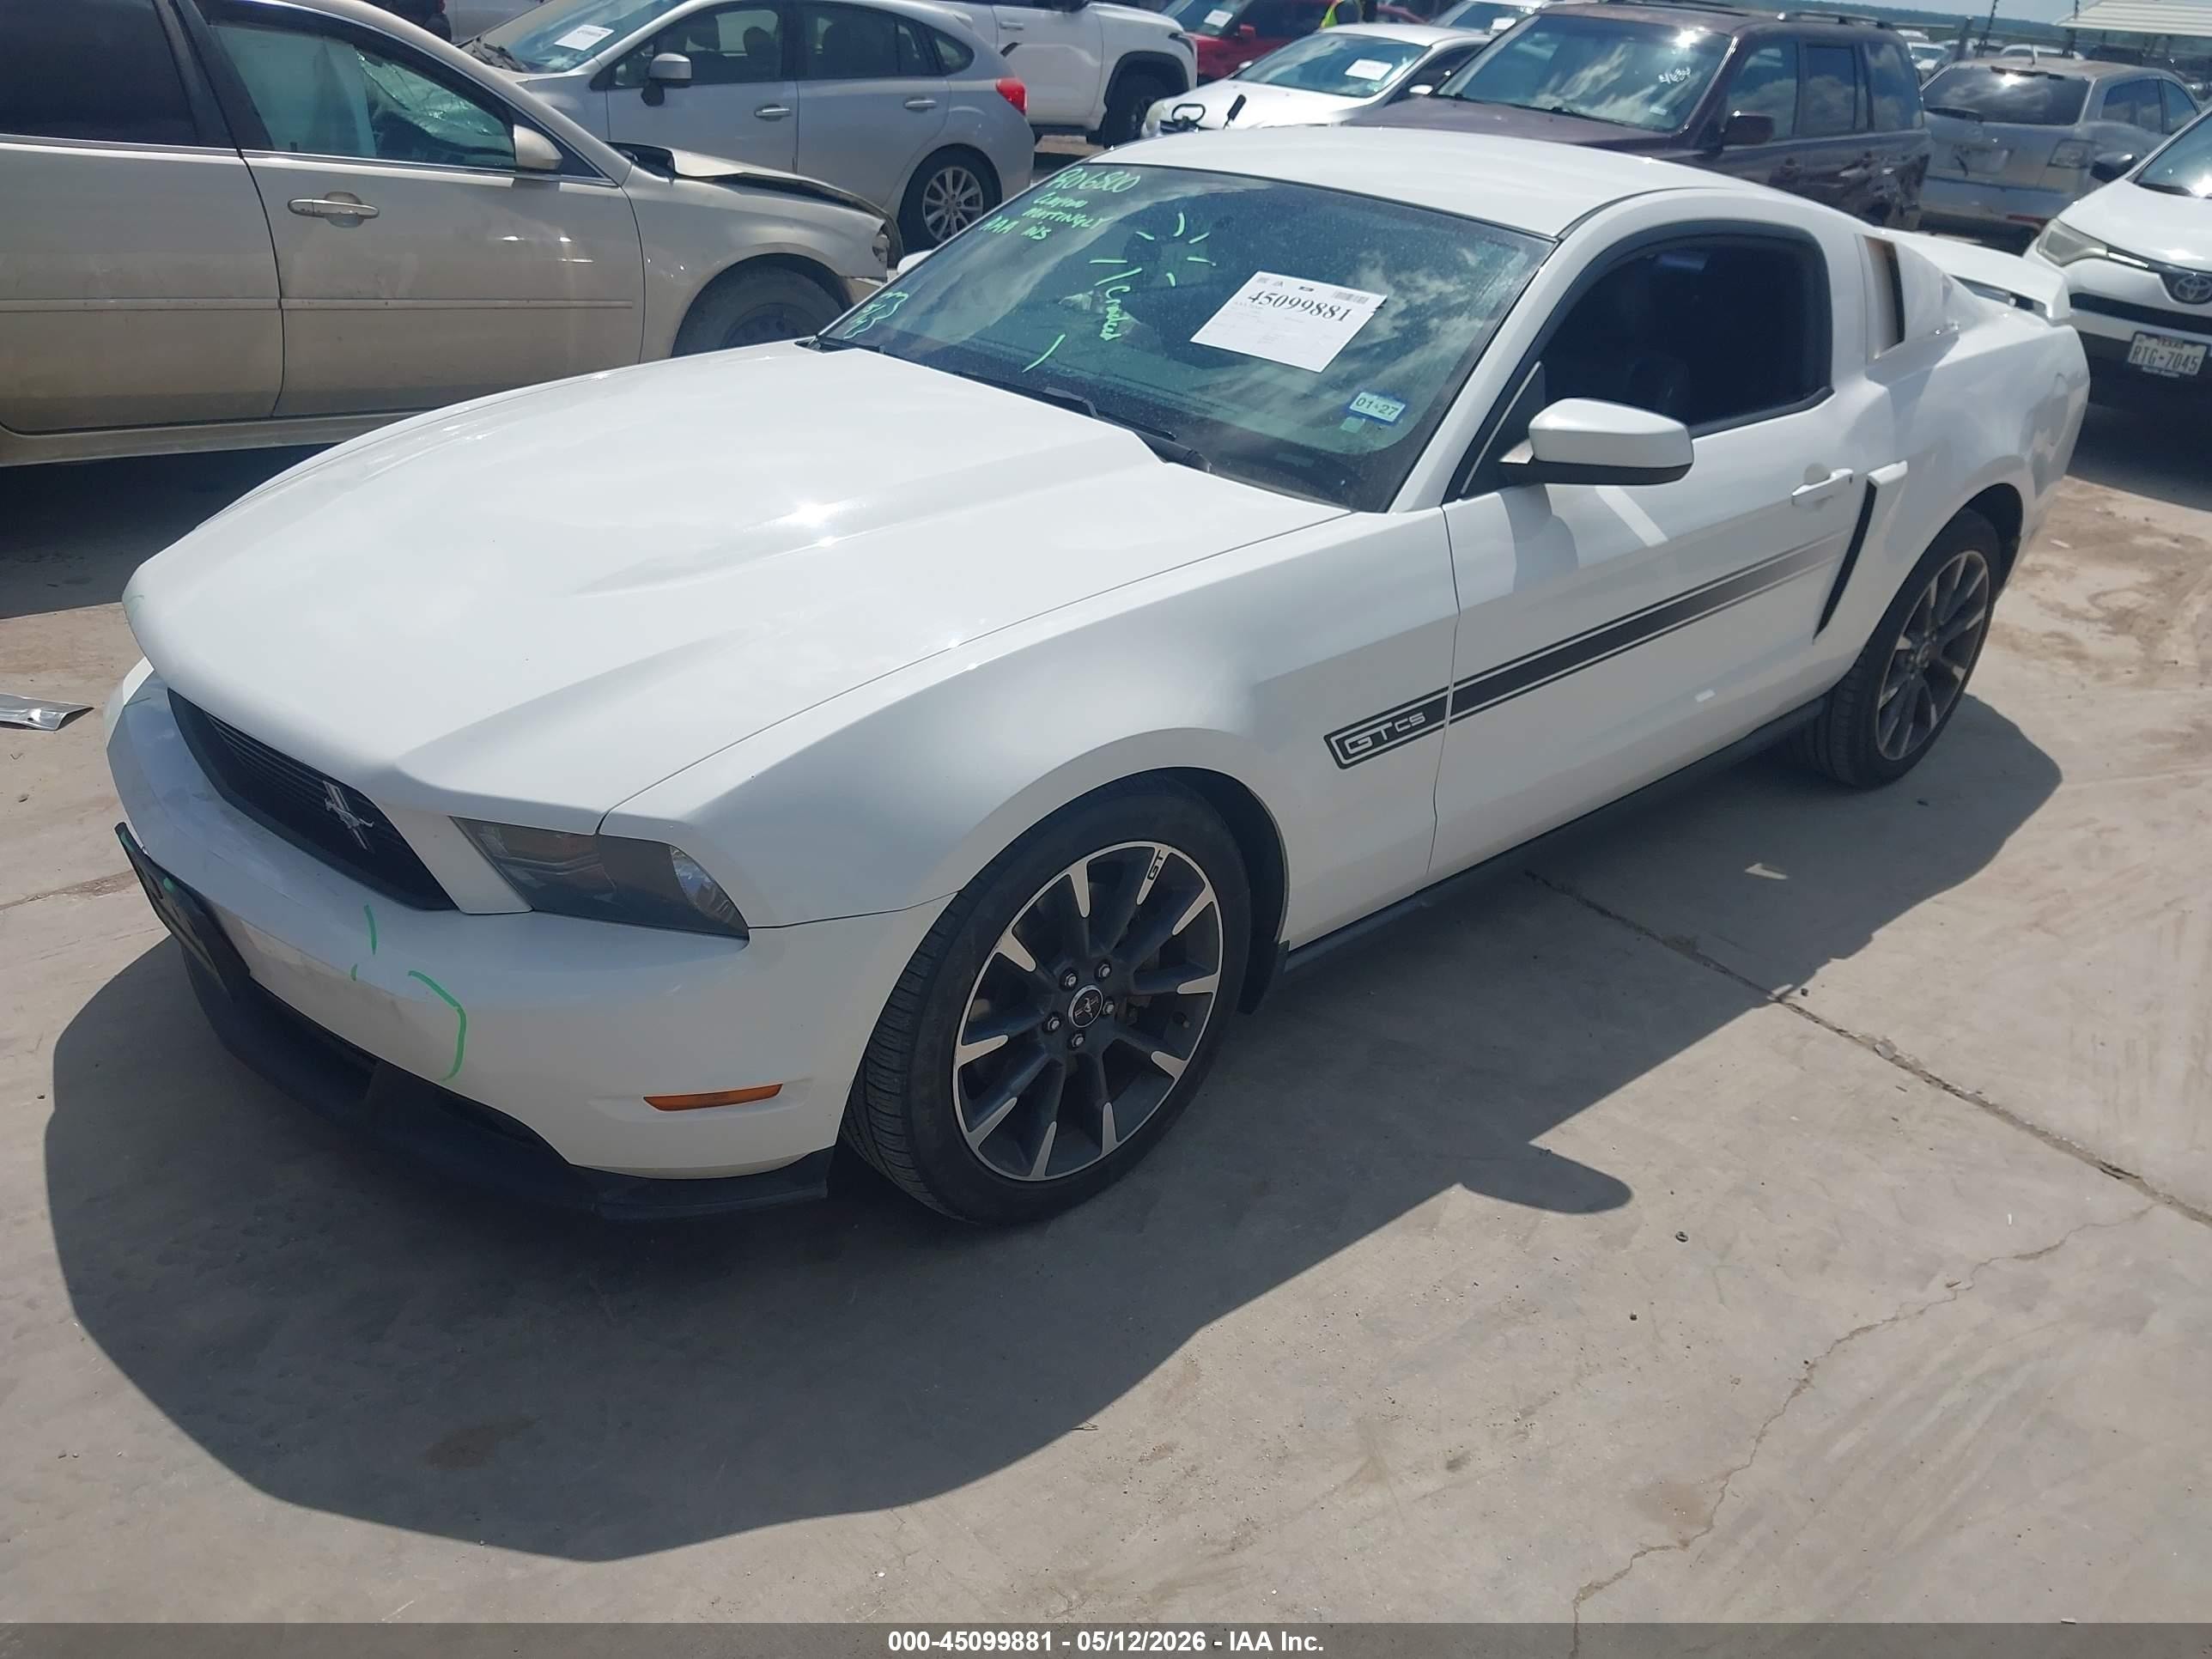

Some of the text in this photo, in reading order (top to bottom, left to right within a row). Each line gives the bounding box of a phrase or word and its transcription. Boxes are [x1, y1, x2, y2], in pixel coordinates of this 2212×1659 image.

[978, 216, 1019, 234] AAA
[1247, 290, 1353, 323] 45099881
[1146, 848, 1164, 881] GT
